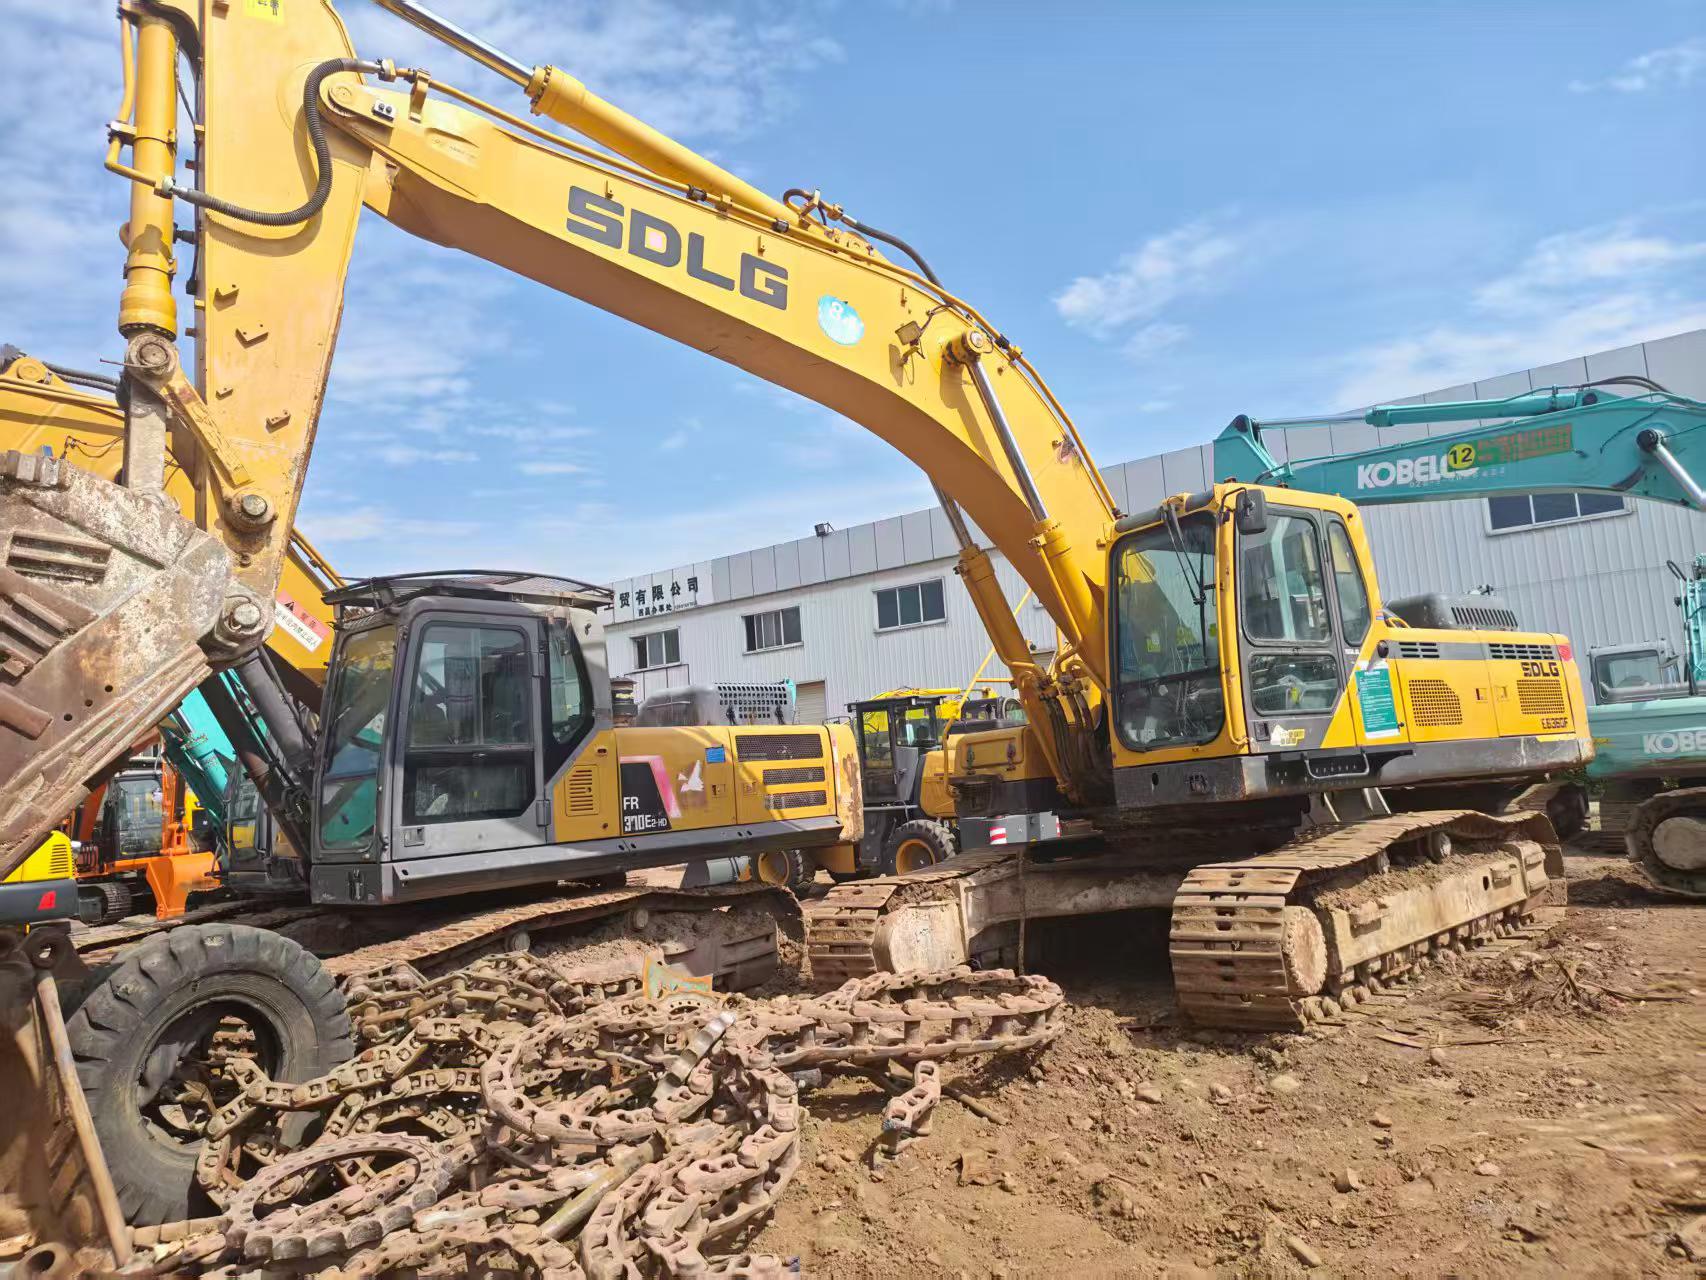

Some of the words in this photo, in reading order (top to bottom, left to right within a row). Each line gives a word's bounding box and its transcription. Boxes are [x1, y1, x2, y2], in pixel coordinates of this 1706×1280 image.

[566, 184, 789, 311] SDLG
[1449, 447, 1473, 465] 12
[1521, 661, 1560, 677] SDLG
[623, 796, 639, 810] FR
